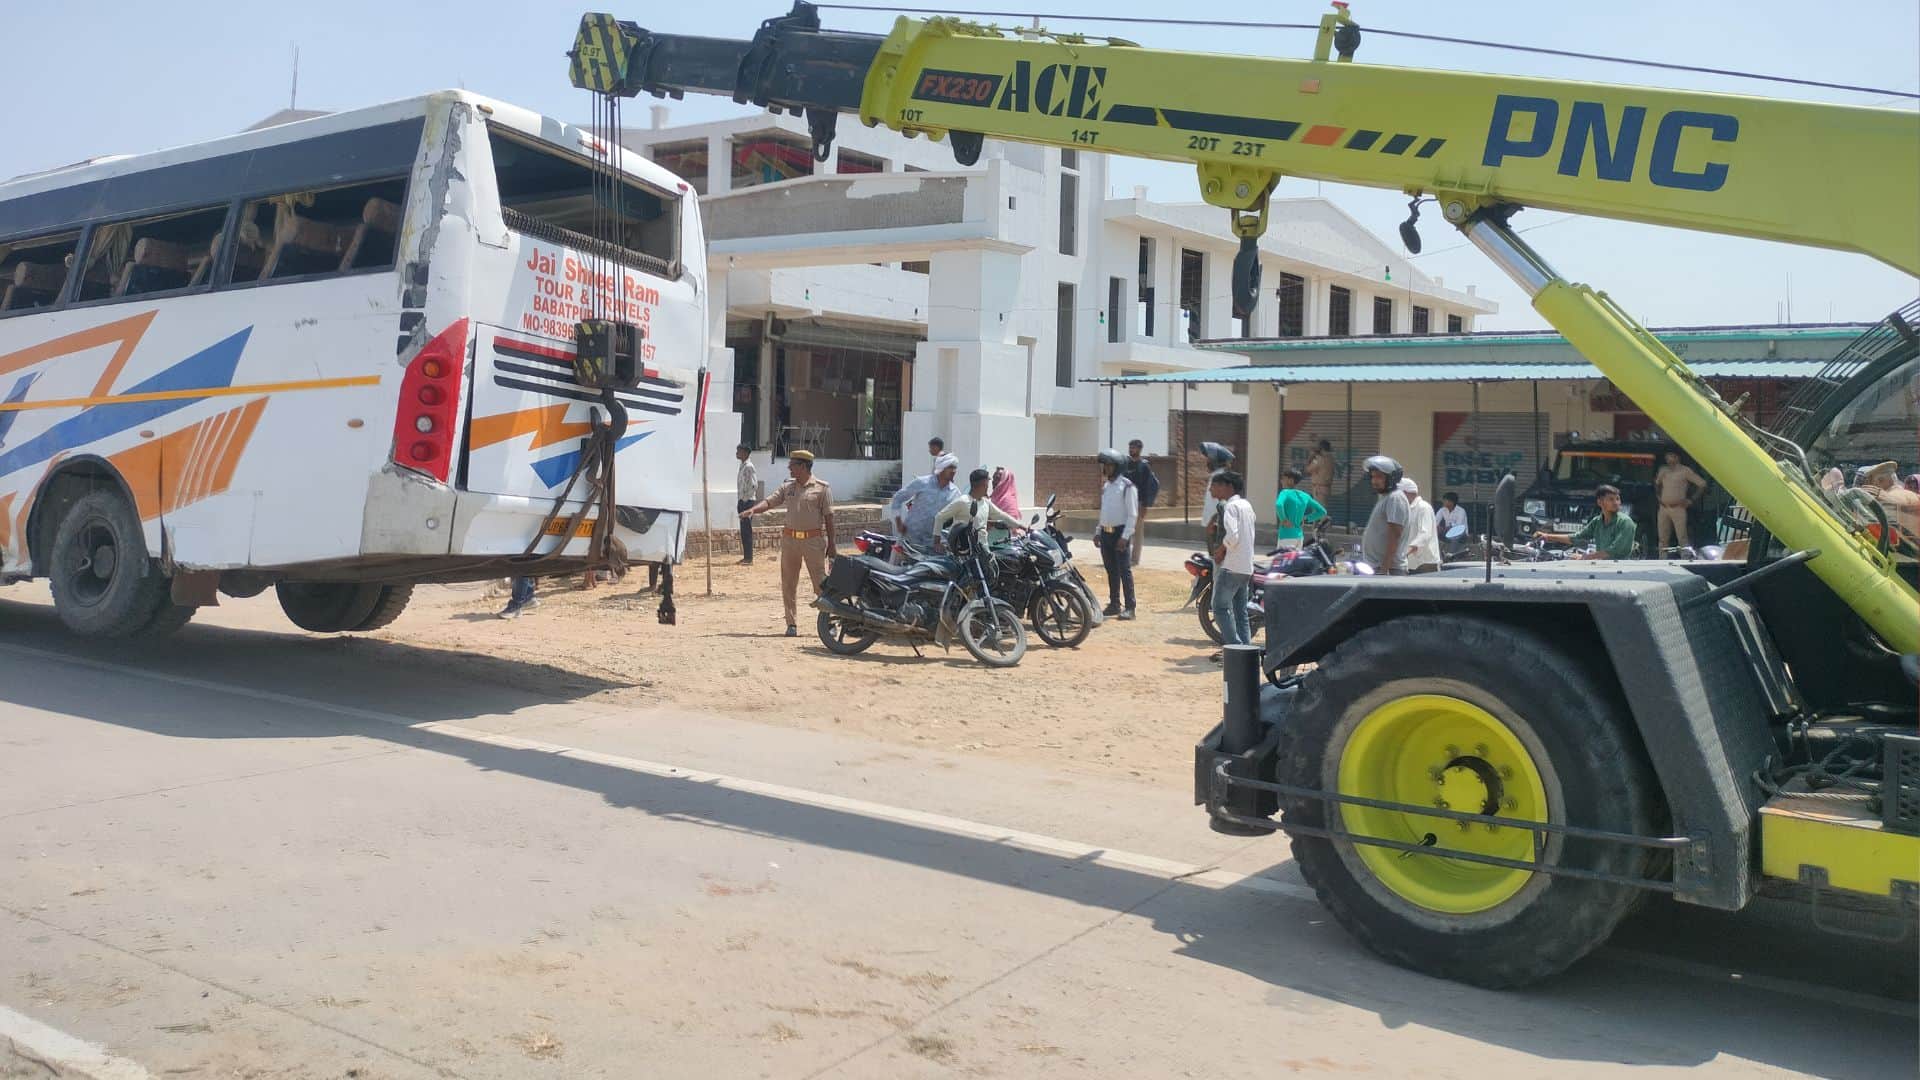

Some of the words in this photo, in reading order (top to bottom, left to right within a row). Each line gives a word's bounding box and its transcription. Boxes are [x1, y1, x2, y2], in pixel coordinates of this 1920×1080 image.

[918, 74, 992, 101] FX230
[997, 60, 1107, 121] ACE
[901, 108, 923, 122] 10T
[1072, 129, 1099, 145] 14T
[1187, 135, 1221, 151] 20T
[1232, 141, 1266, 157] 23T
[1481, 93, 1740, 193] PNC
[527, 247, 556, 275] Jai
[565, 257, 615, 293] Shree
[624, 275, 660, 306] Ram
[535, 276, 573, 301] TOUR
[580, 289, 590, 305] &
